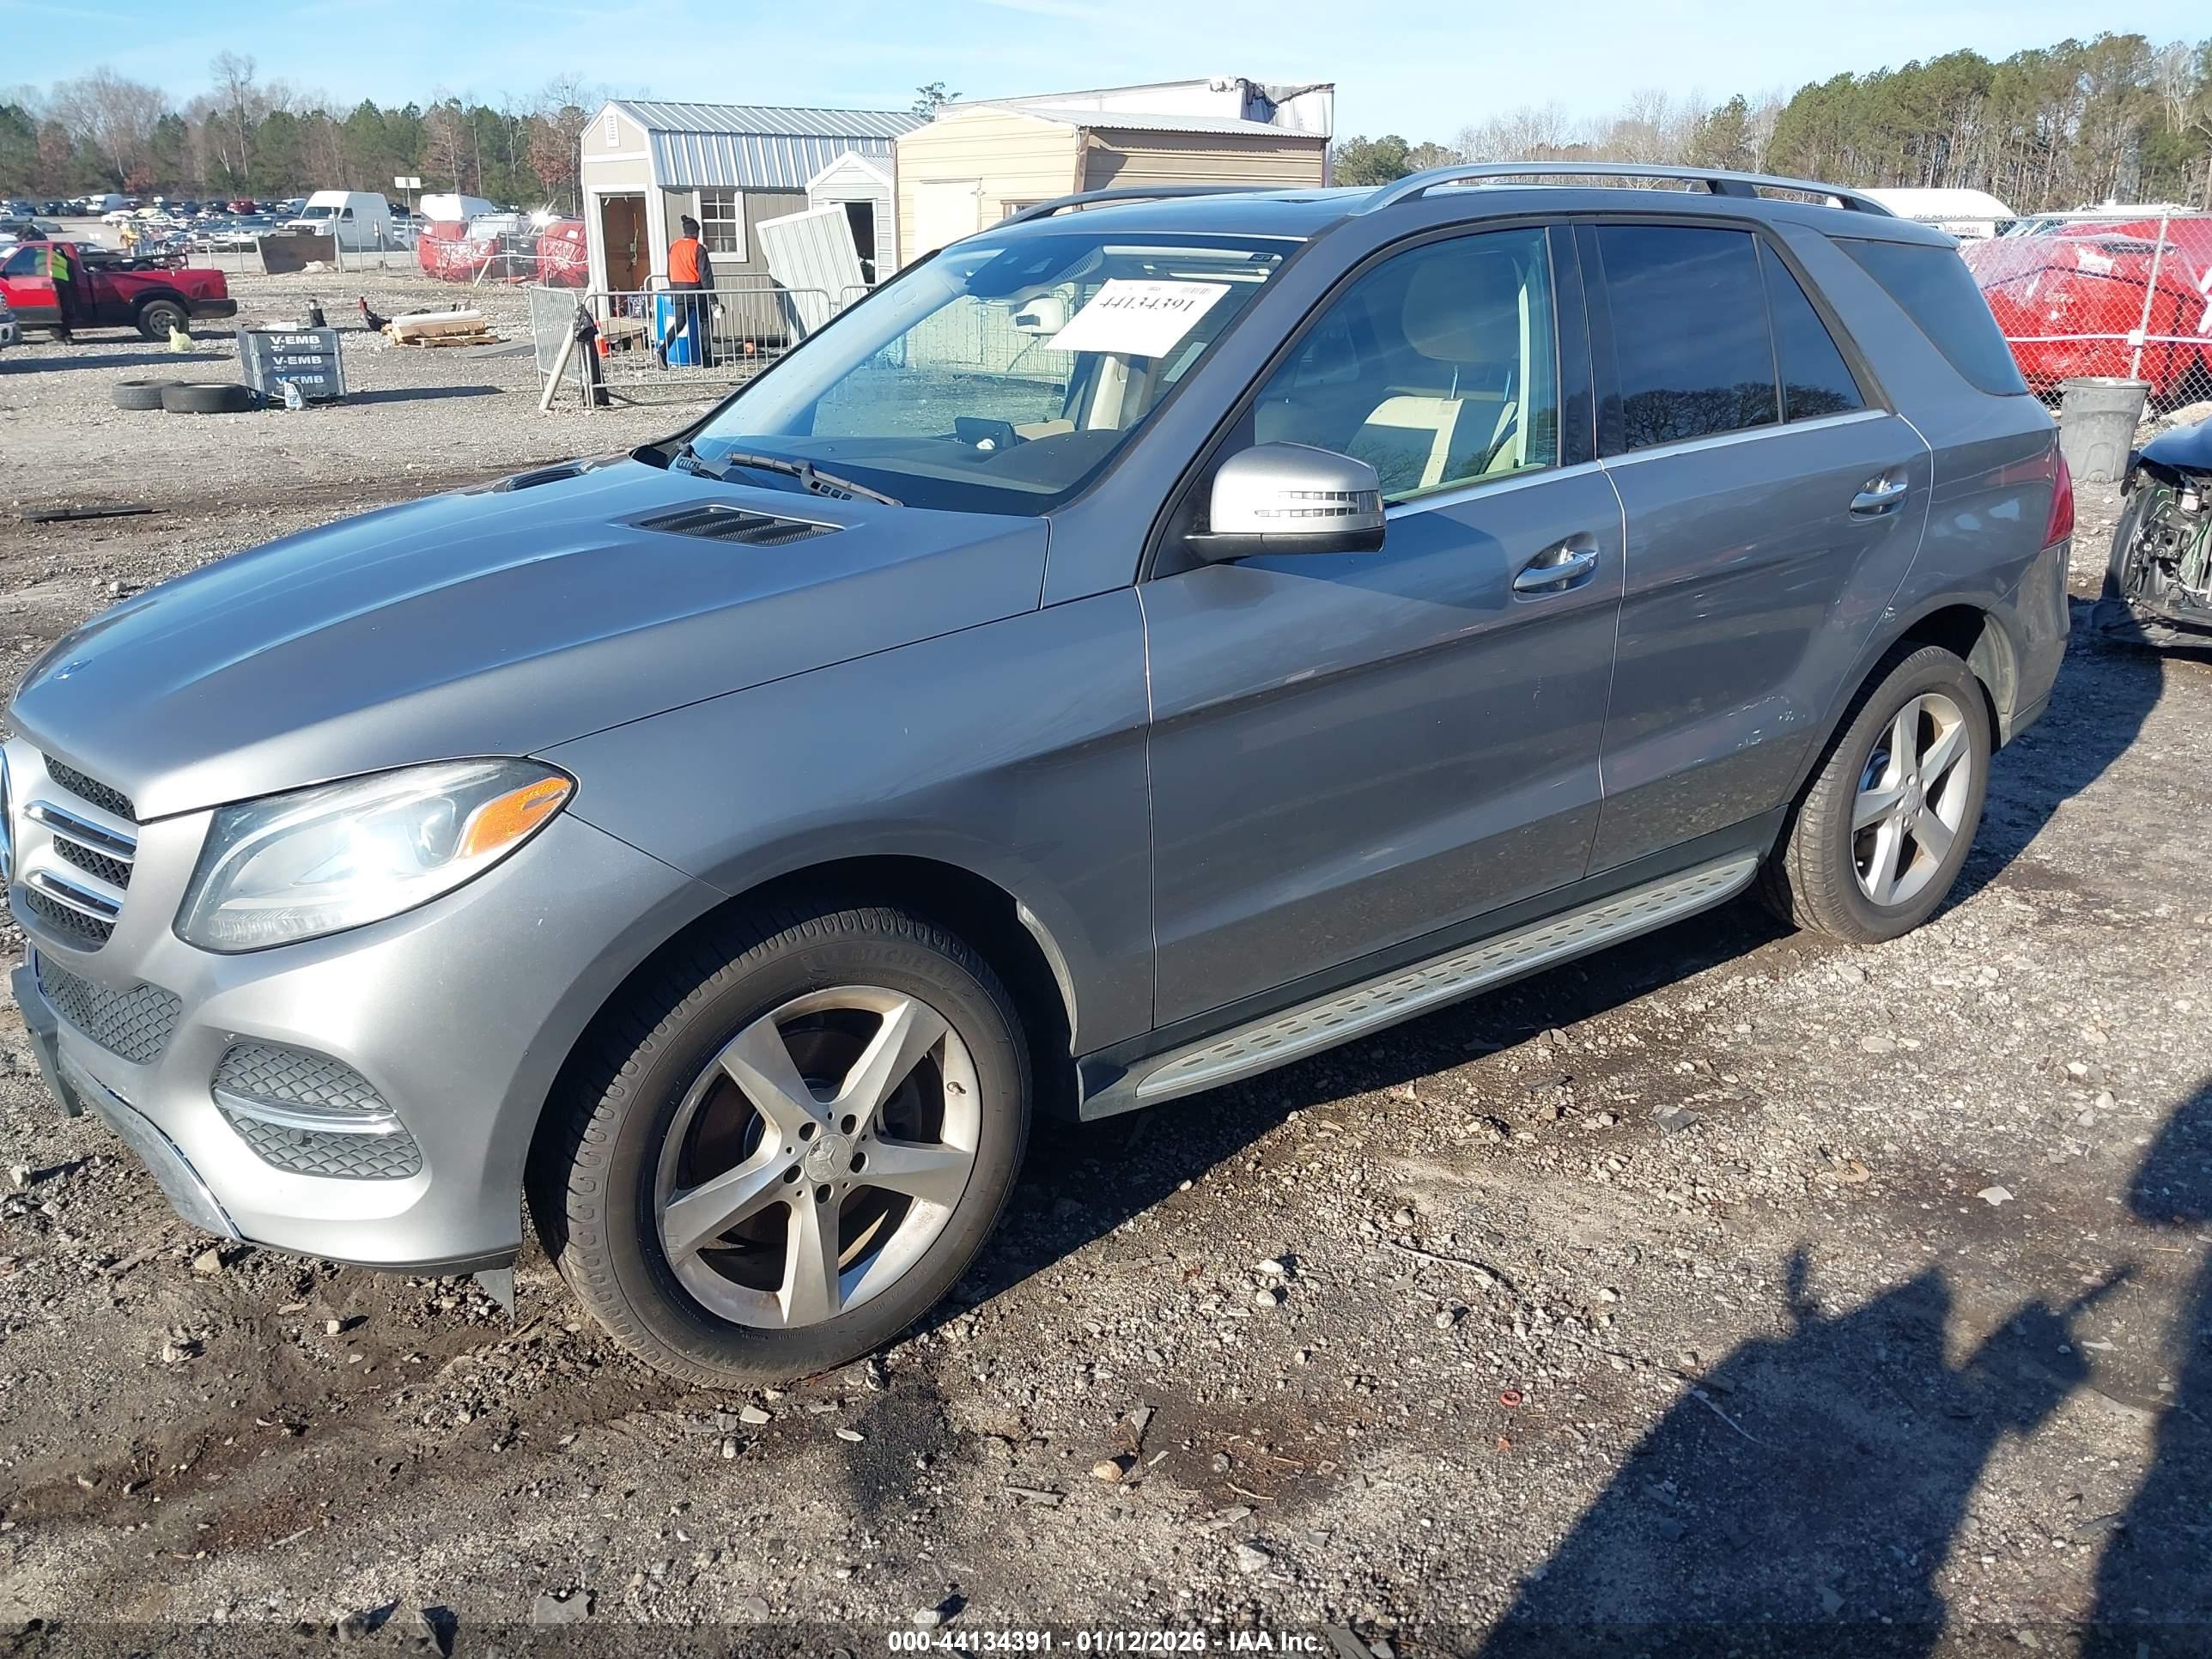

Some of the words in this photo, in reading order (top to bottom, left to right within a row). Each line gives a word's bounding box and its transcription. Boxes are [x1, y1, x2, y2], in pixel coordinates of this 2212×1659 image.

[1099, 296, 1196, 312] 44134391
[269, 335, 321, 344] V-EMB
[271, 356, 323, 365] V-EMB
[275, 375, 325, 385] VEMB
